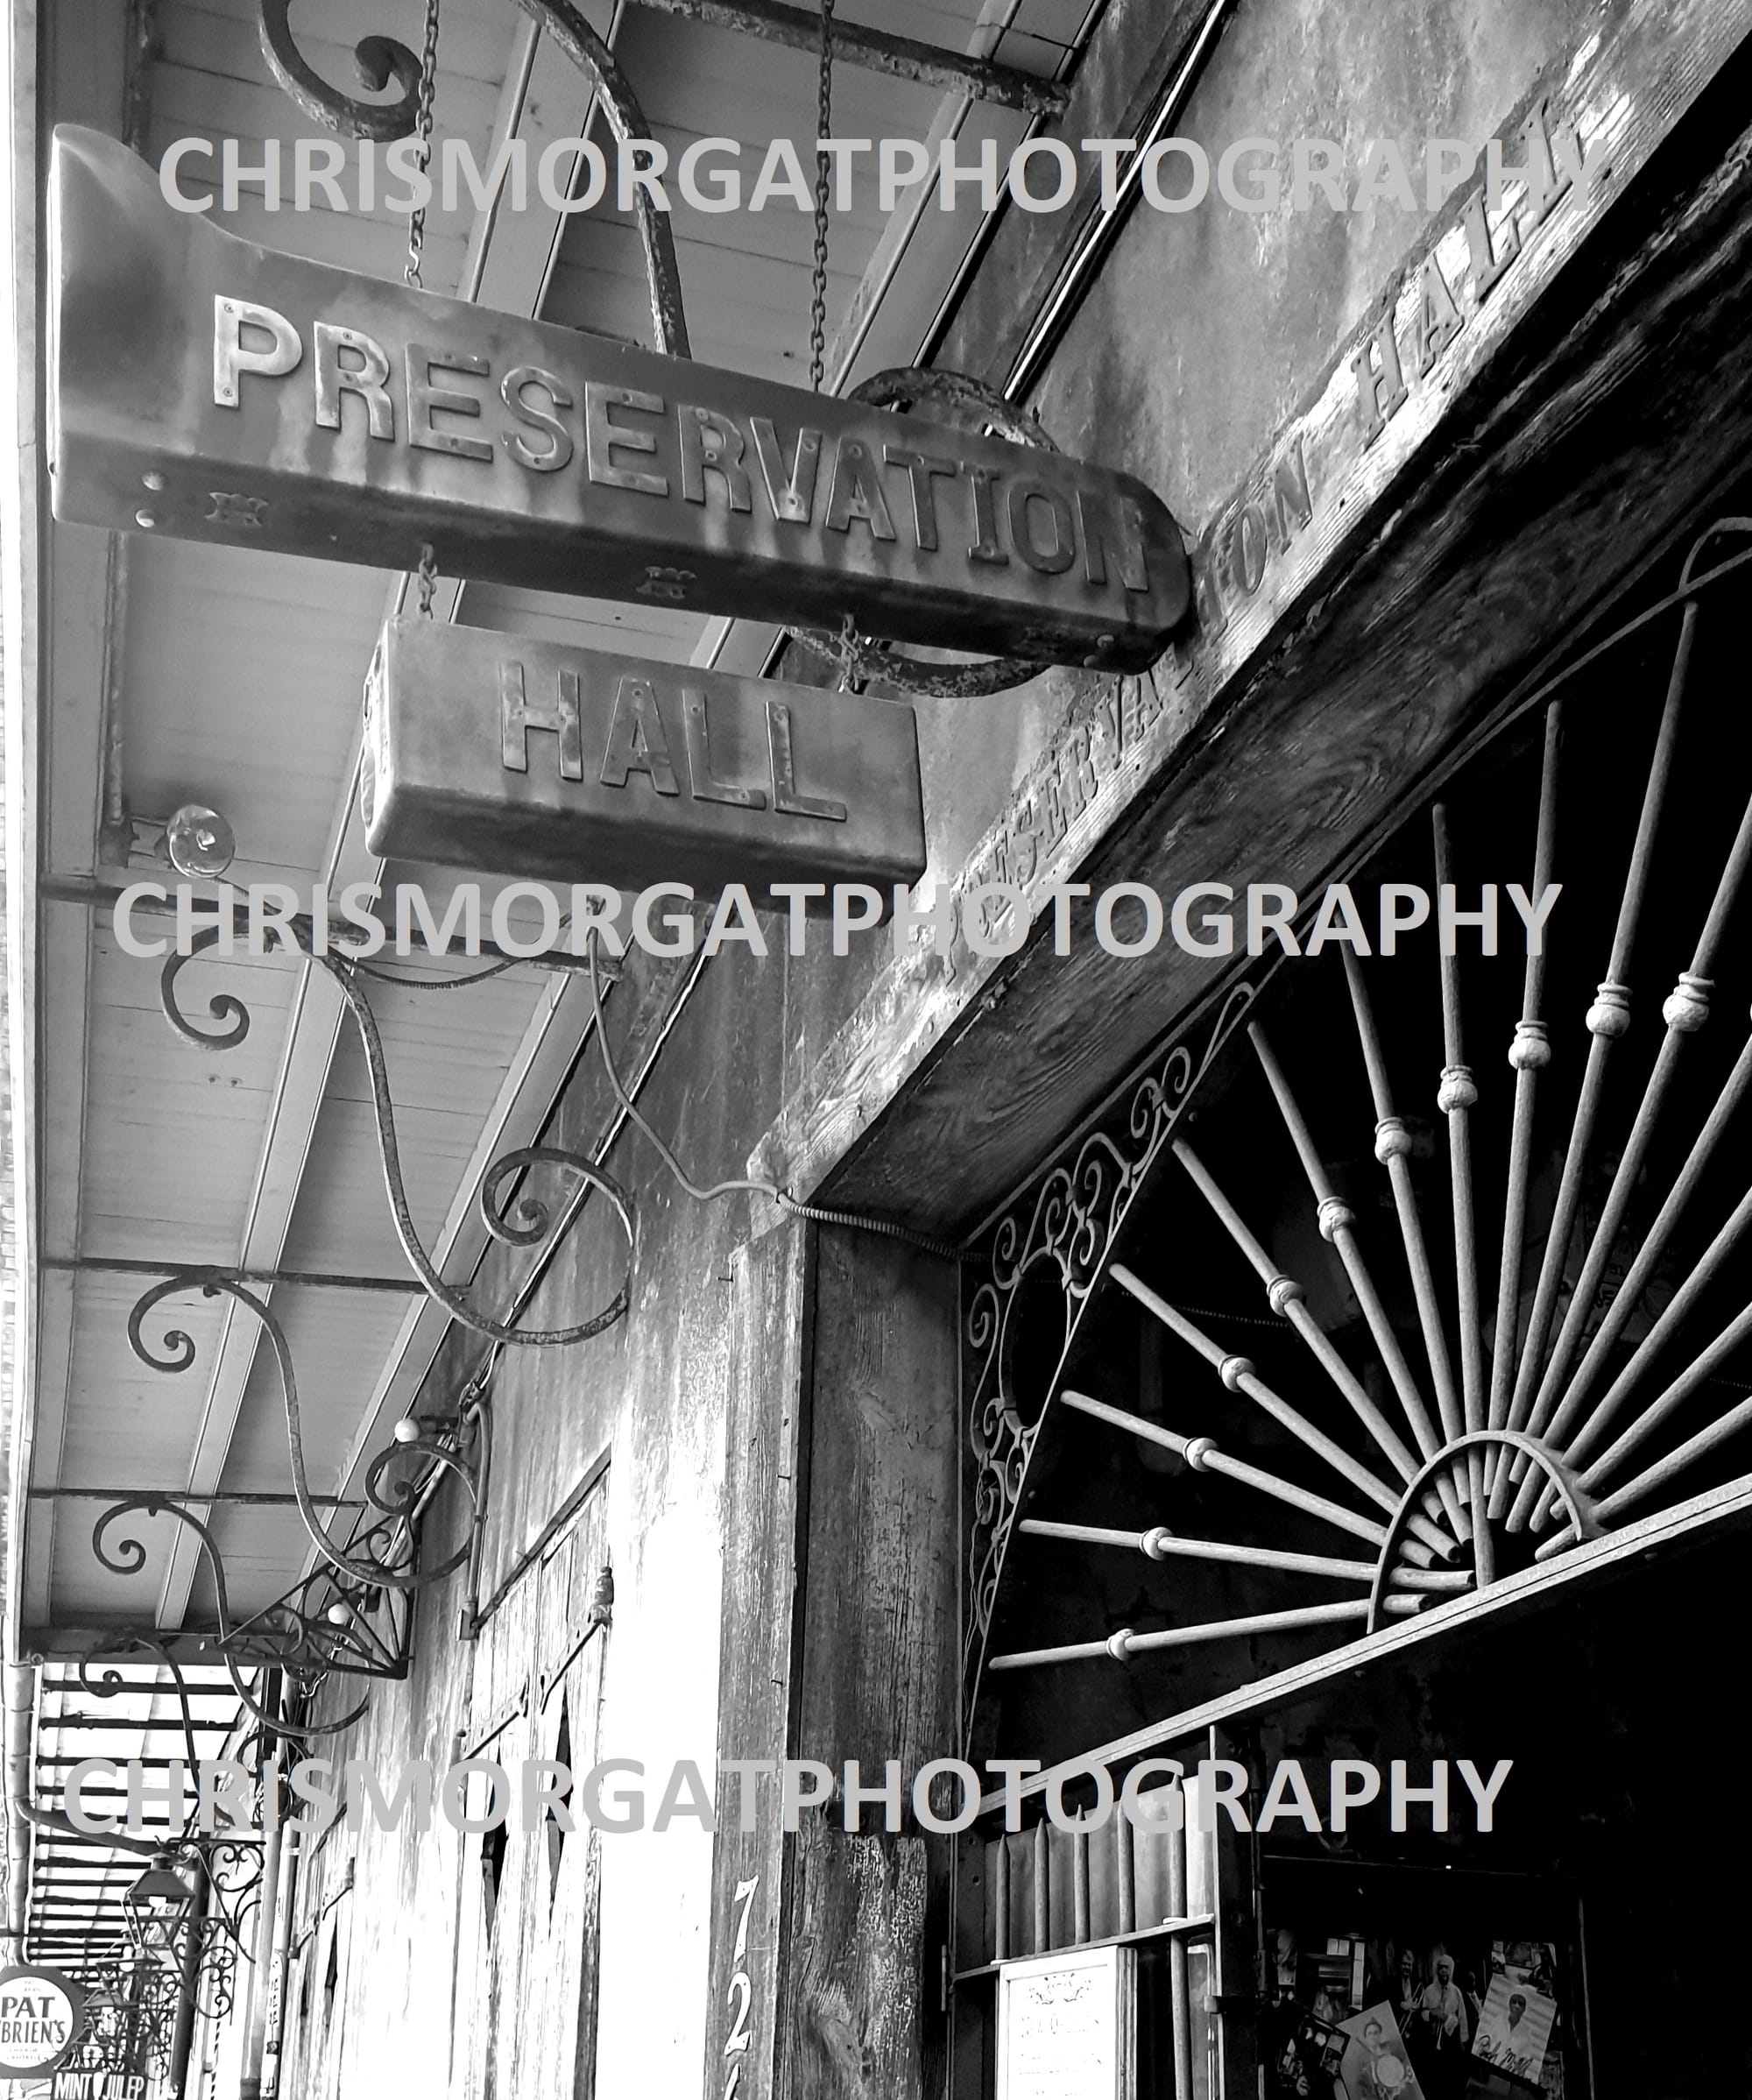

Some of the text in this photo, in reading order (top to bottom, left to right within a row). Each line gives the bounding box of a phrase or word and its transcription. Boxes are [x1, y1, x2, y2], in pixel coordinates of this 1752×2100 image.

[214, 293, 1148, 591] PRESERVATION
[499, 659, 847, 822] HALL
[934, 433, 1312, 987] PESERVAION
[0, 2019, 66, 2044] BRIEN'S
[1, 1996, 55, 2019] PAT
[53, 2072, 145, 2100] MINT JULEP
